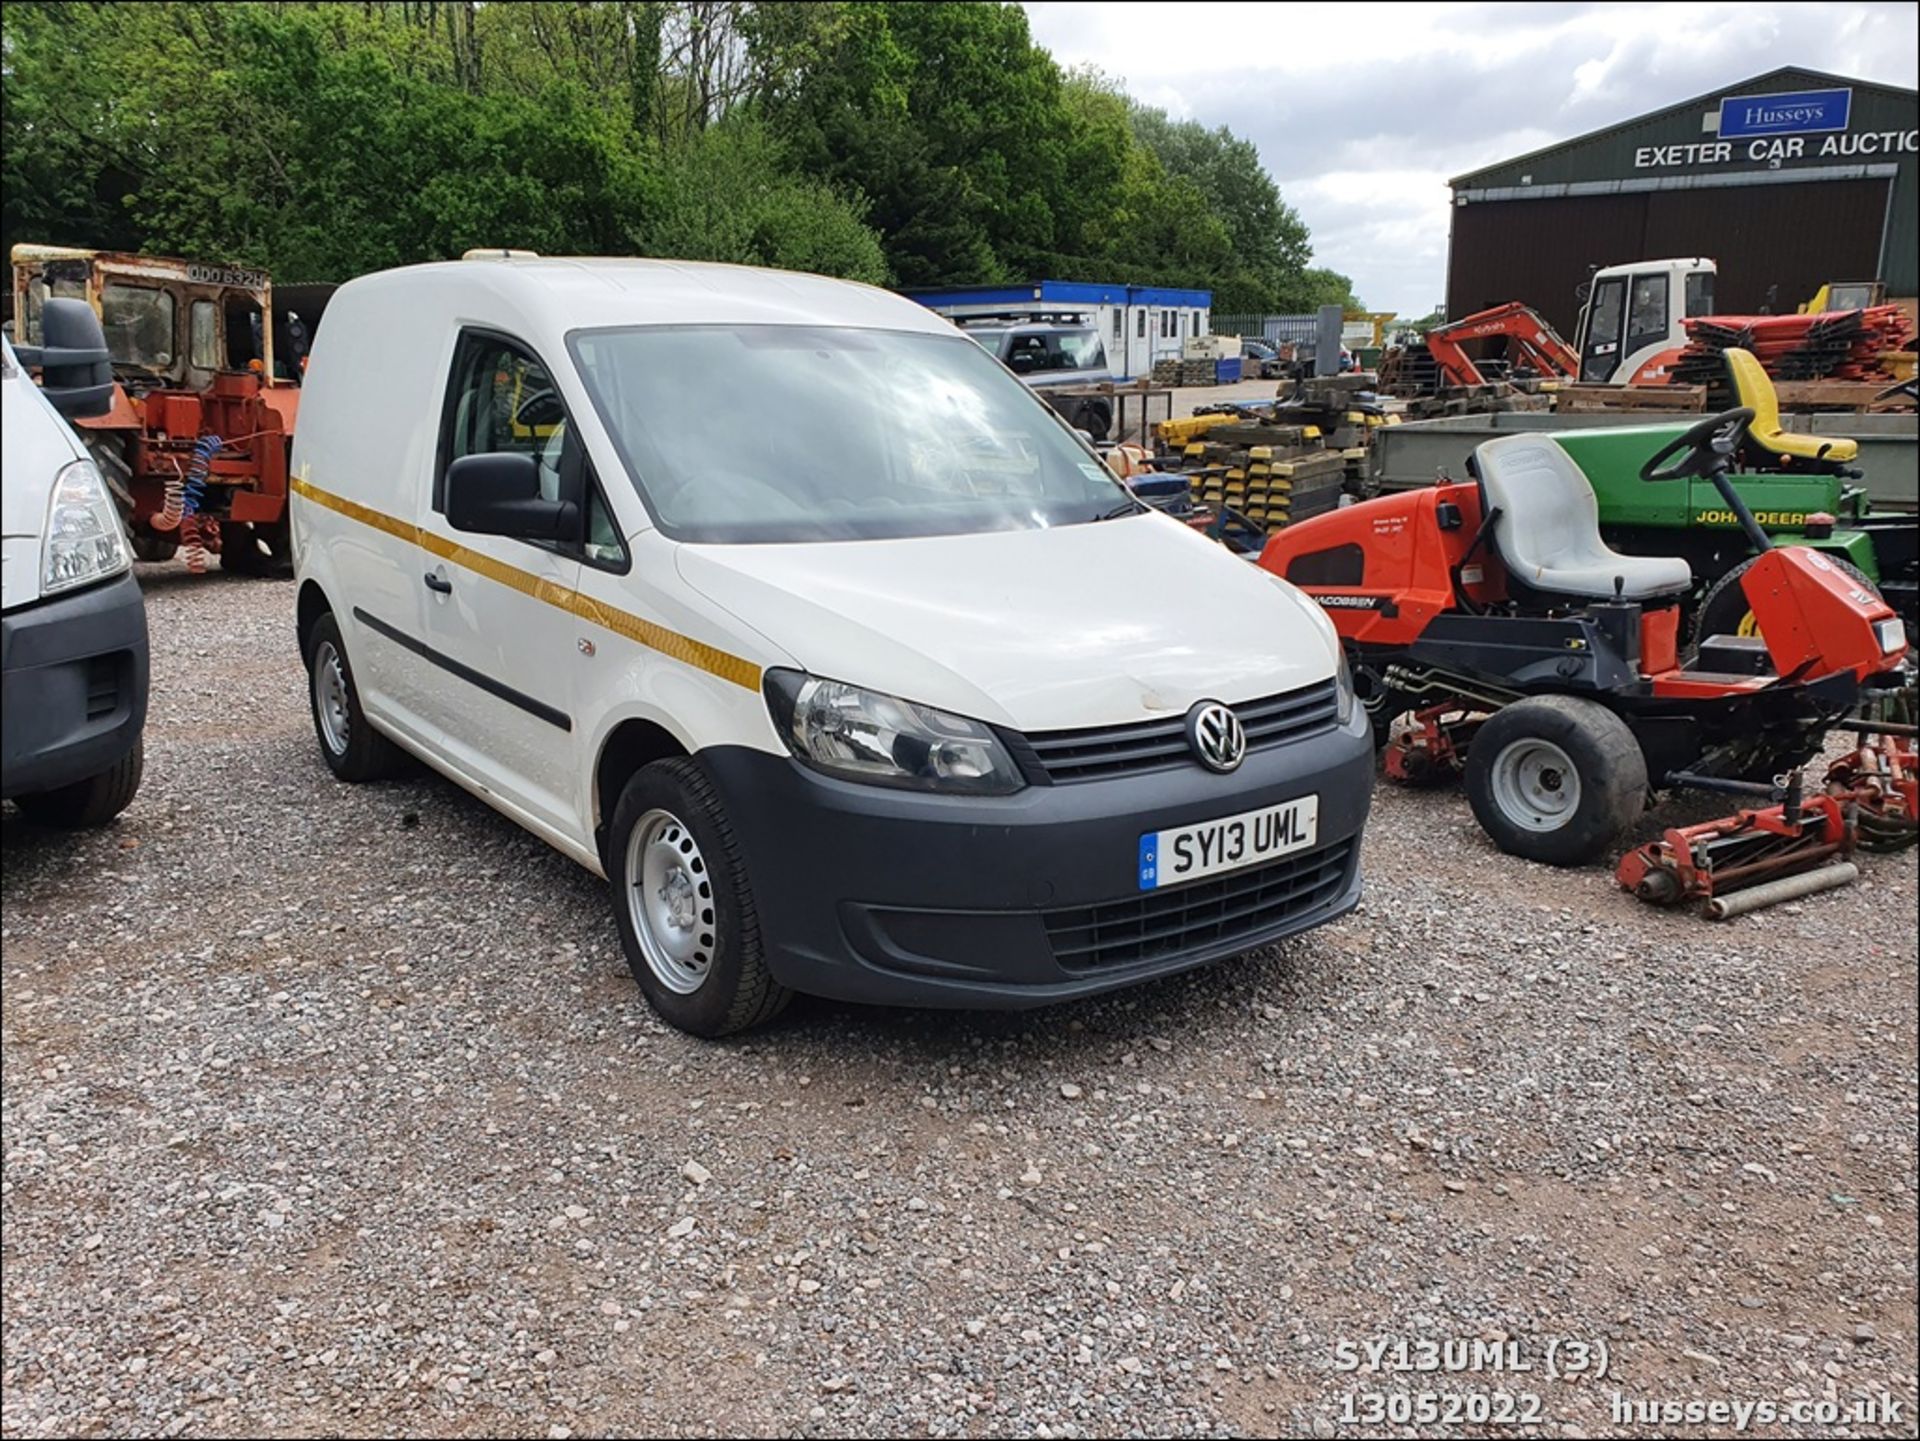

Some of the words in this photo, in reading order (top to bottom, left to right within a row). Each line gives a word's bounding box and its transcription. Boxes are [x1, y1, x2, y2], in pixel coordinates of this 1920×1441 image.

[1745, 105, 1823, 124] Husseys
[1634, 141, 1731, 168] EXETER
[1748, 137, 1804, 161] CAR
[1173, 822, 1245, 873] SY13
[1253, 807, 1307, 852] UML
